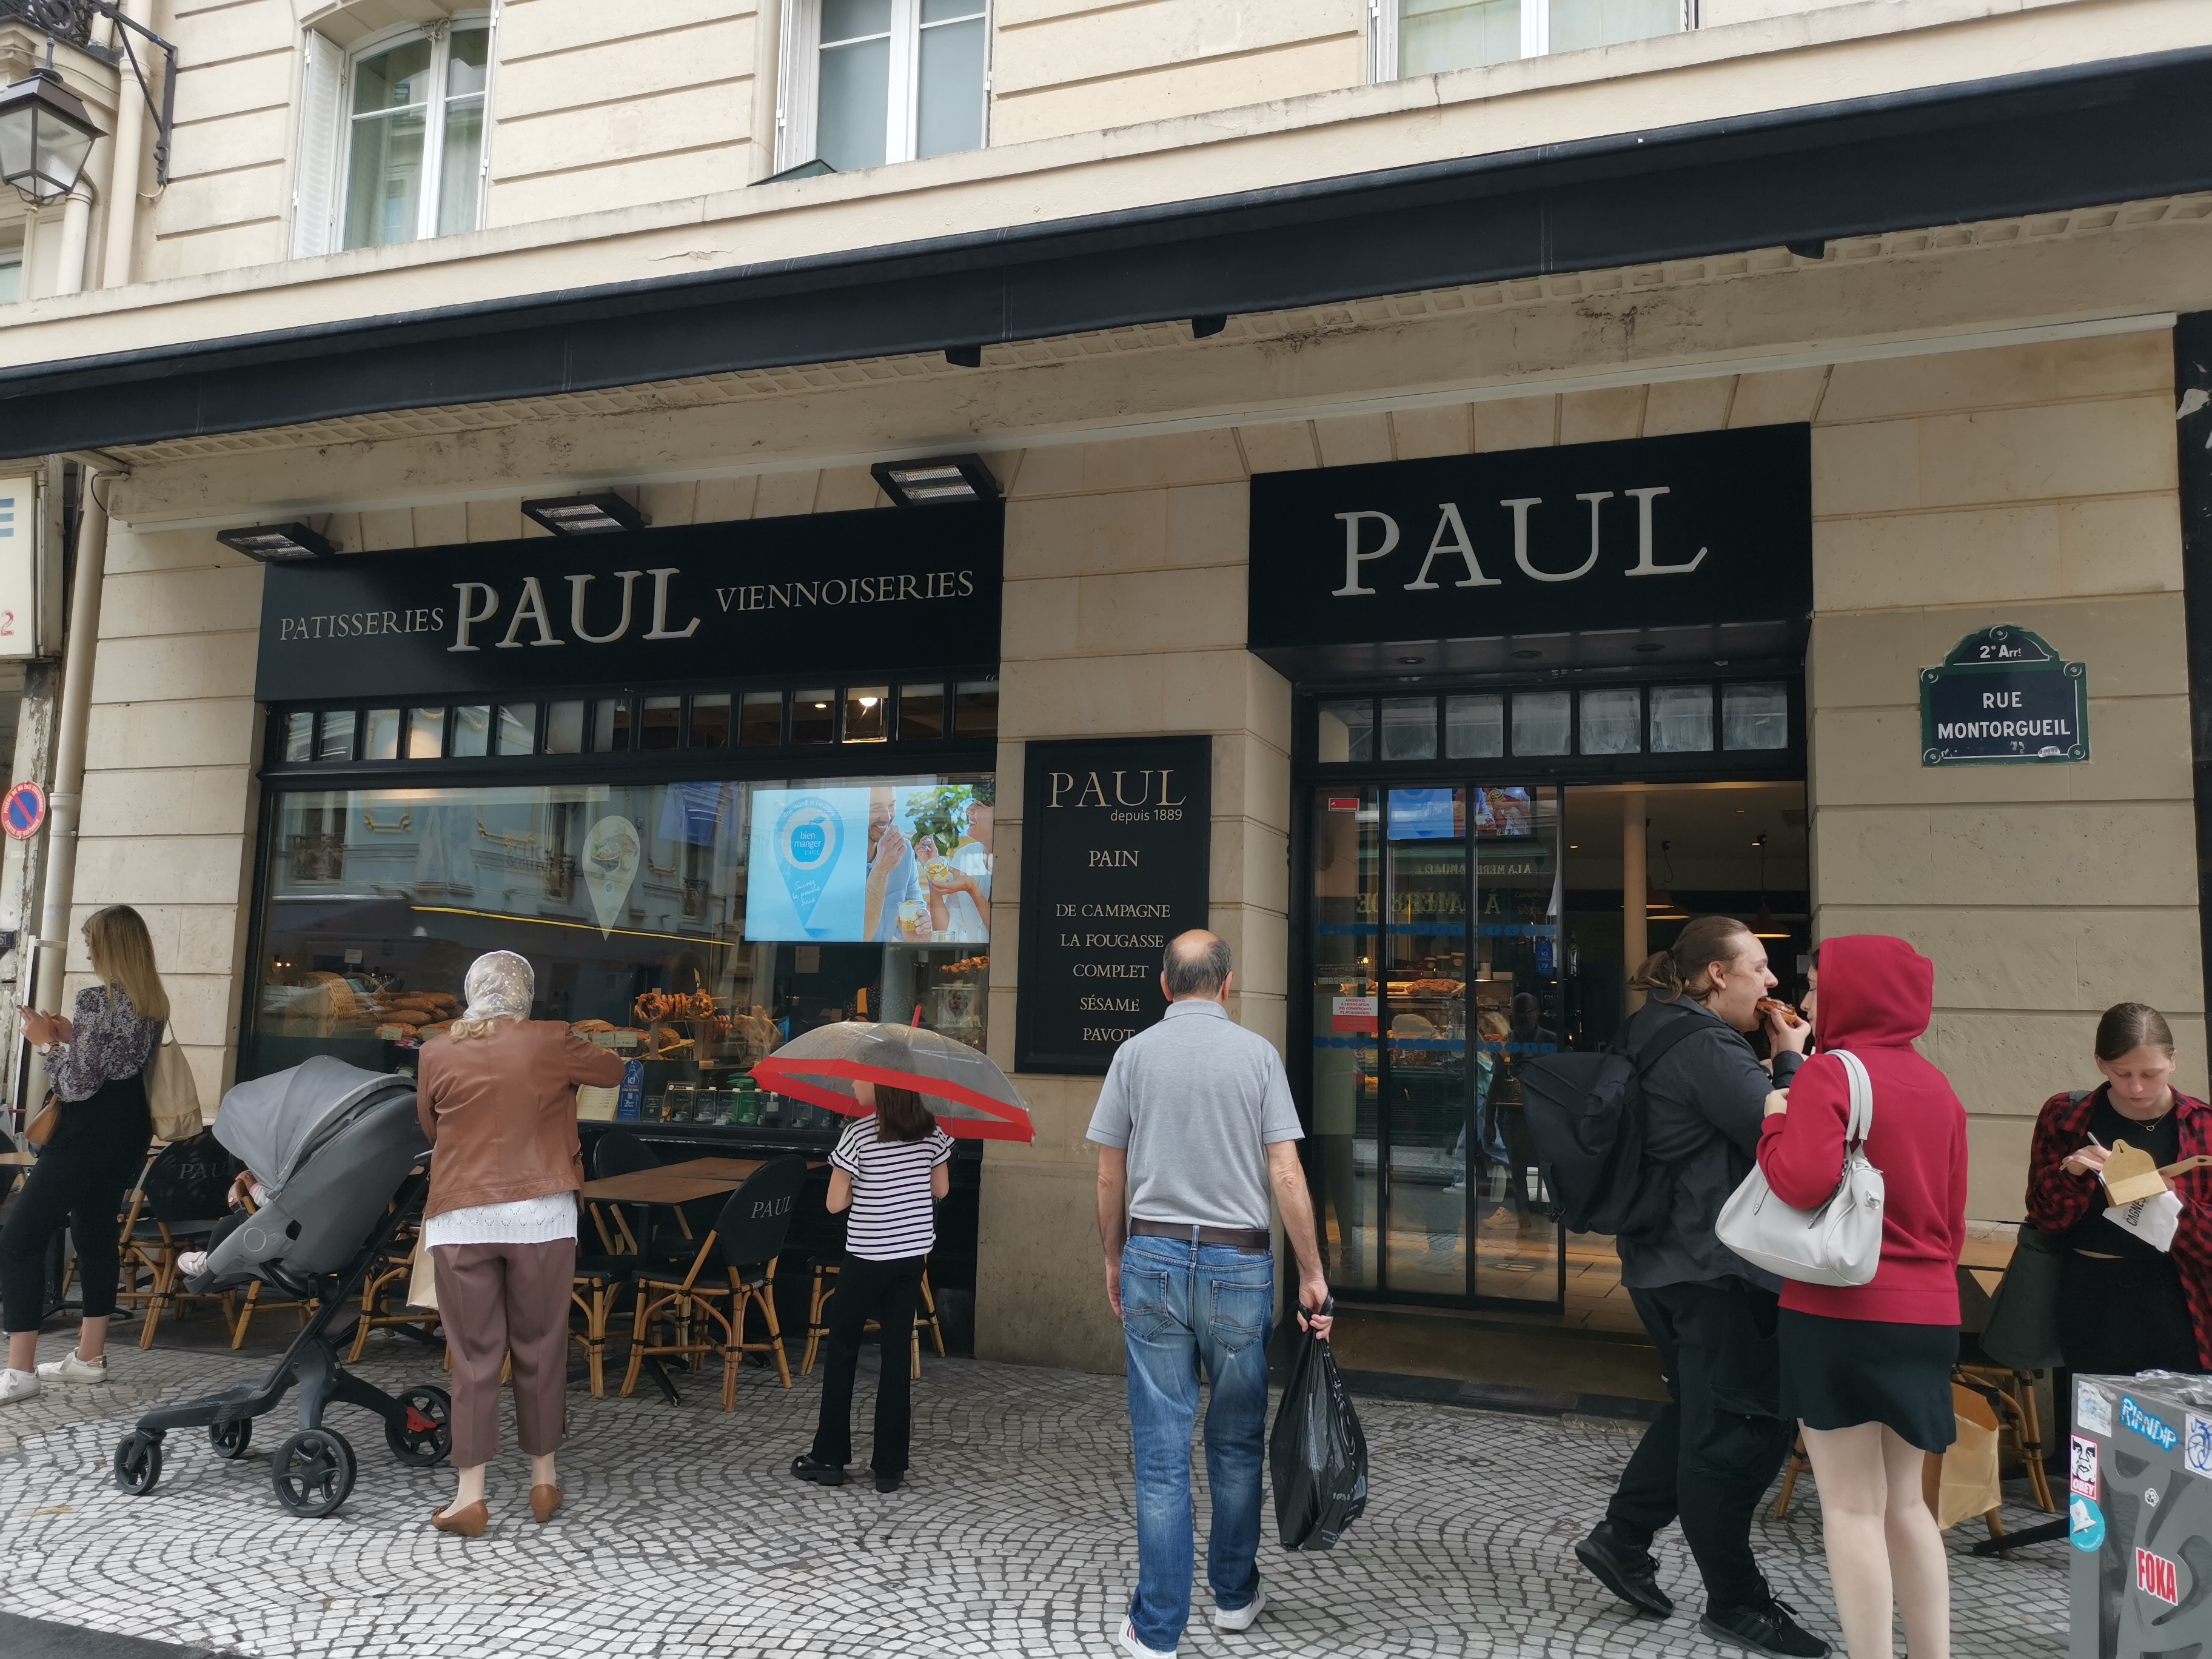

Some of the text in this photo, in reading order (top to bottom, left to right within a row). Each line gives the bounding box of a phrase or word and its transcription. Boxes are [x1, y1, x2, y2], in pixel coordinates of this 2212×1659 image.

[1332, 486, 1708, 597] PAUL
[279, 568, 974, 652] PATISSERIES PAUL VIENNOISERIES
[1982, 691, 2023, 709] RUE
[1938, 719, 2071, 739] MONTORGUEIL
[1047, 769, 1187, 808] PAUL
[1110, 809, 1182, 825] depuis 1889
[800, 831, 816, 839] bien
[794, 840, 822, 849] manger
[1088, 850, 1140, 867] PAIN
[1056, 903, 1170, 917] DE CAMPAGNE
[1060, 934, 1164, 948] LA FOUGASSE
[1073, 964, 1149, 978] COMPLET
[1080, 994, 1140, 1011] SÉSAME
[1082, 1028, 1135, 1042] PAVOT
[178, 1161, 227, 1180] PAU
[749, 1195, 792, 1219] PAUL
[2072, 1478, 2094, 1496] OBEY
[2137, 1548, 2177, 1604] FOKA
